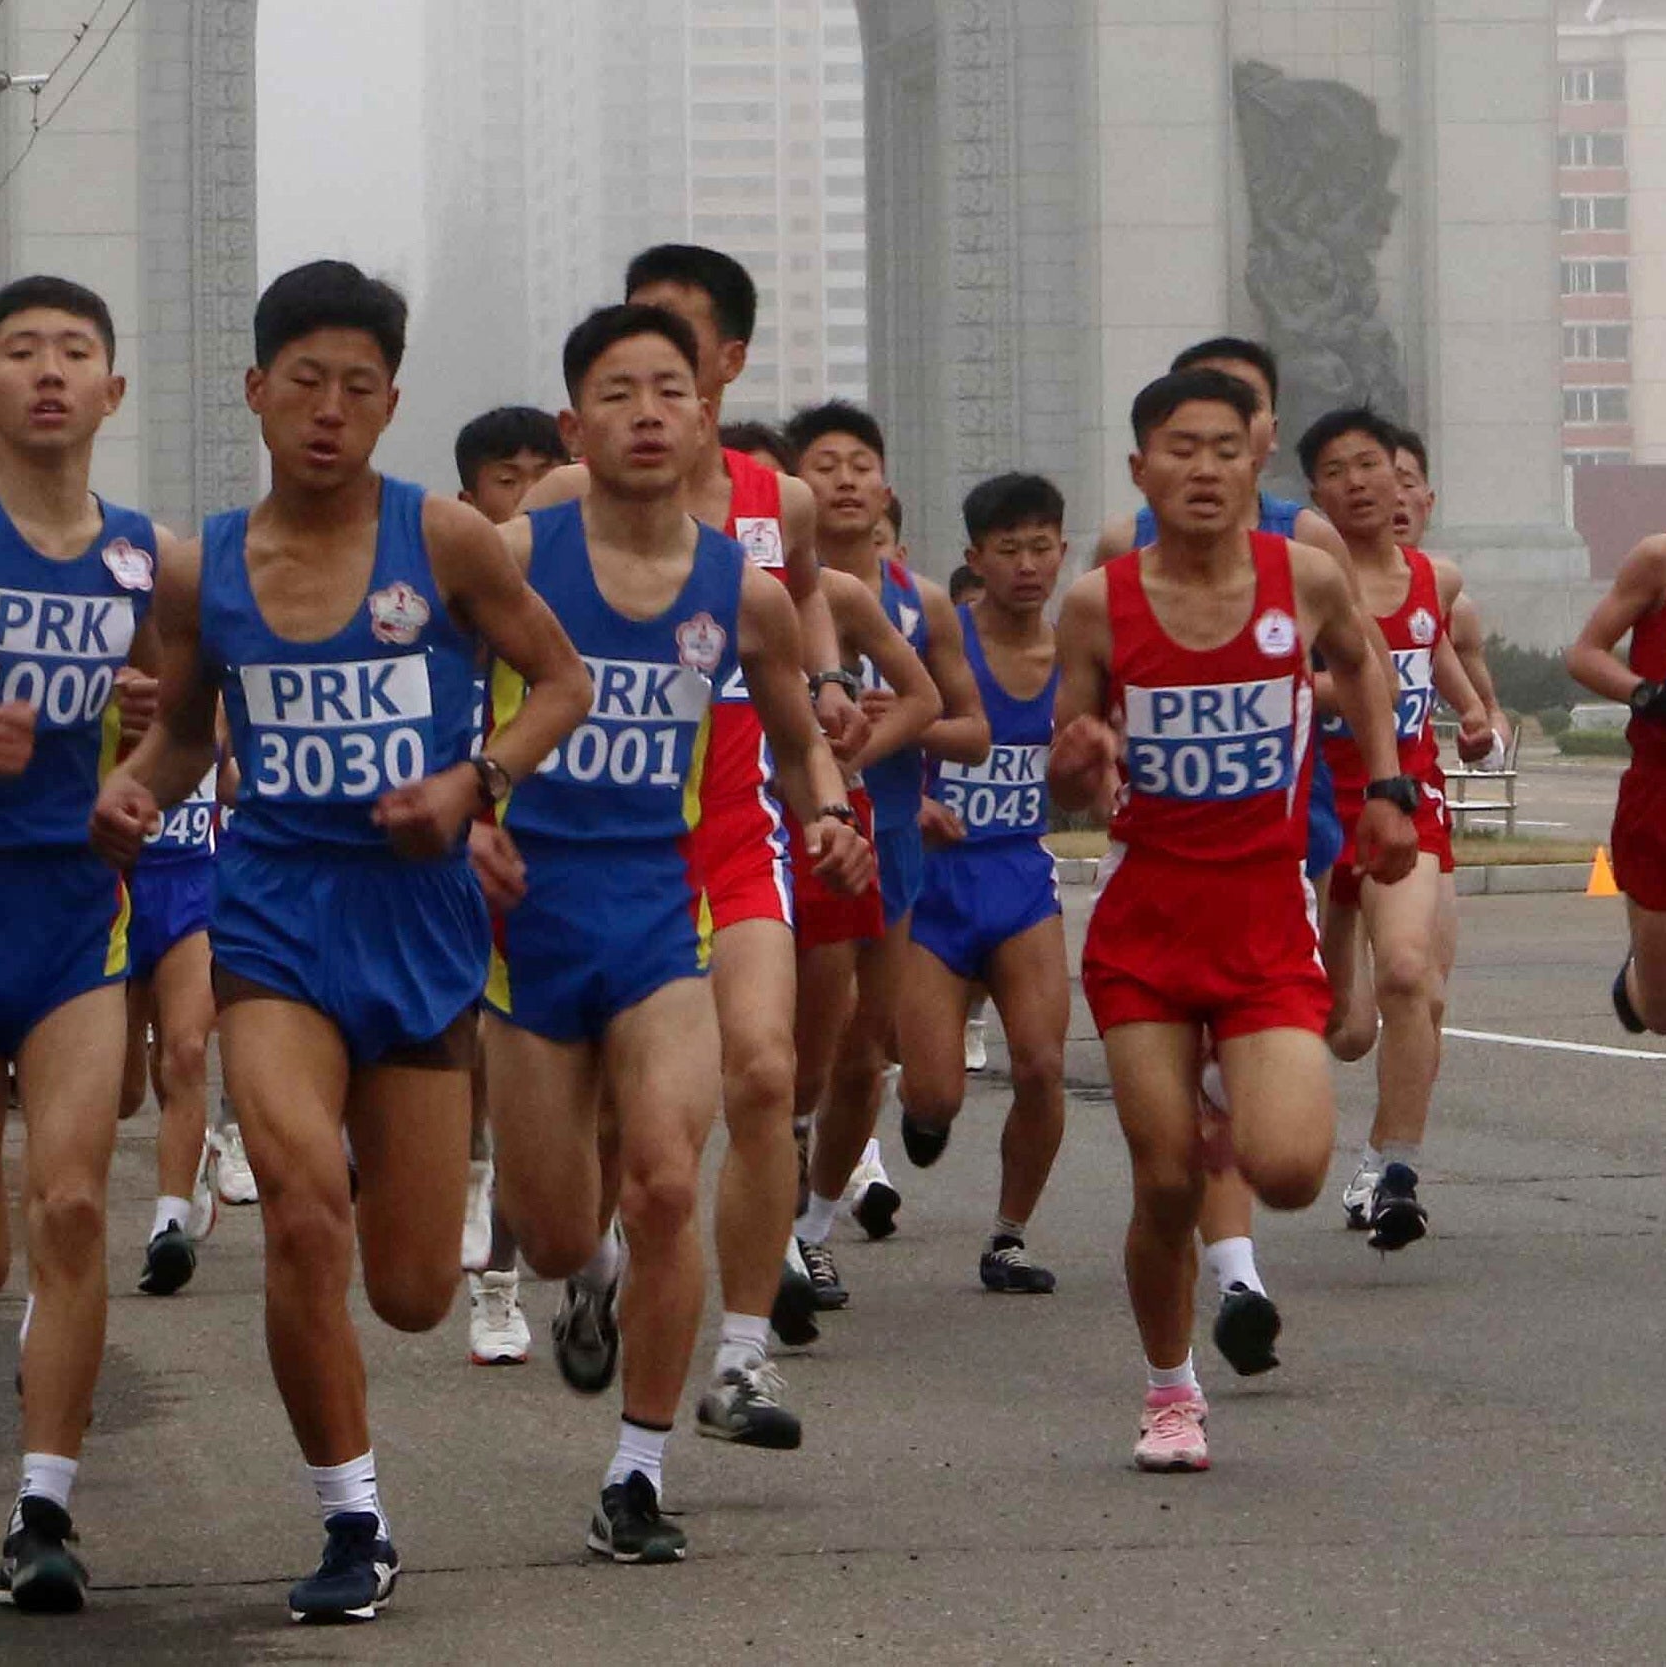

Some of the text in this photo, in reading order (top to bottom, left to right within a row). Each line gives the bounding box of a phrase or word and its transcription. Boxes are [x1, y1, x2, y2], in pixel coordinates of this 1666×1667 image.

[270, 663, 401, 722] PRK
[590, 664, 680, 716] RK
[1151, 684, 1269, 734] PRK
[256, 728, 424, 797] 3030
[535, 724, 681, 785] 001
[961, 747, 1043, 782] RK
[1135, 737, 1283, 796] 3053
[943, 785, 1041, 827] 3043
